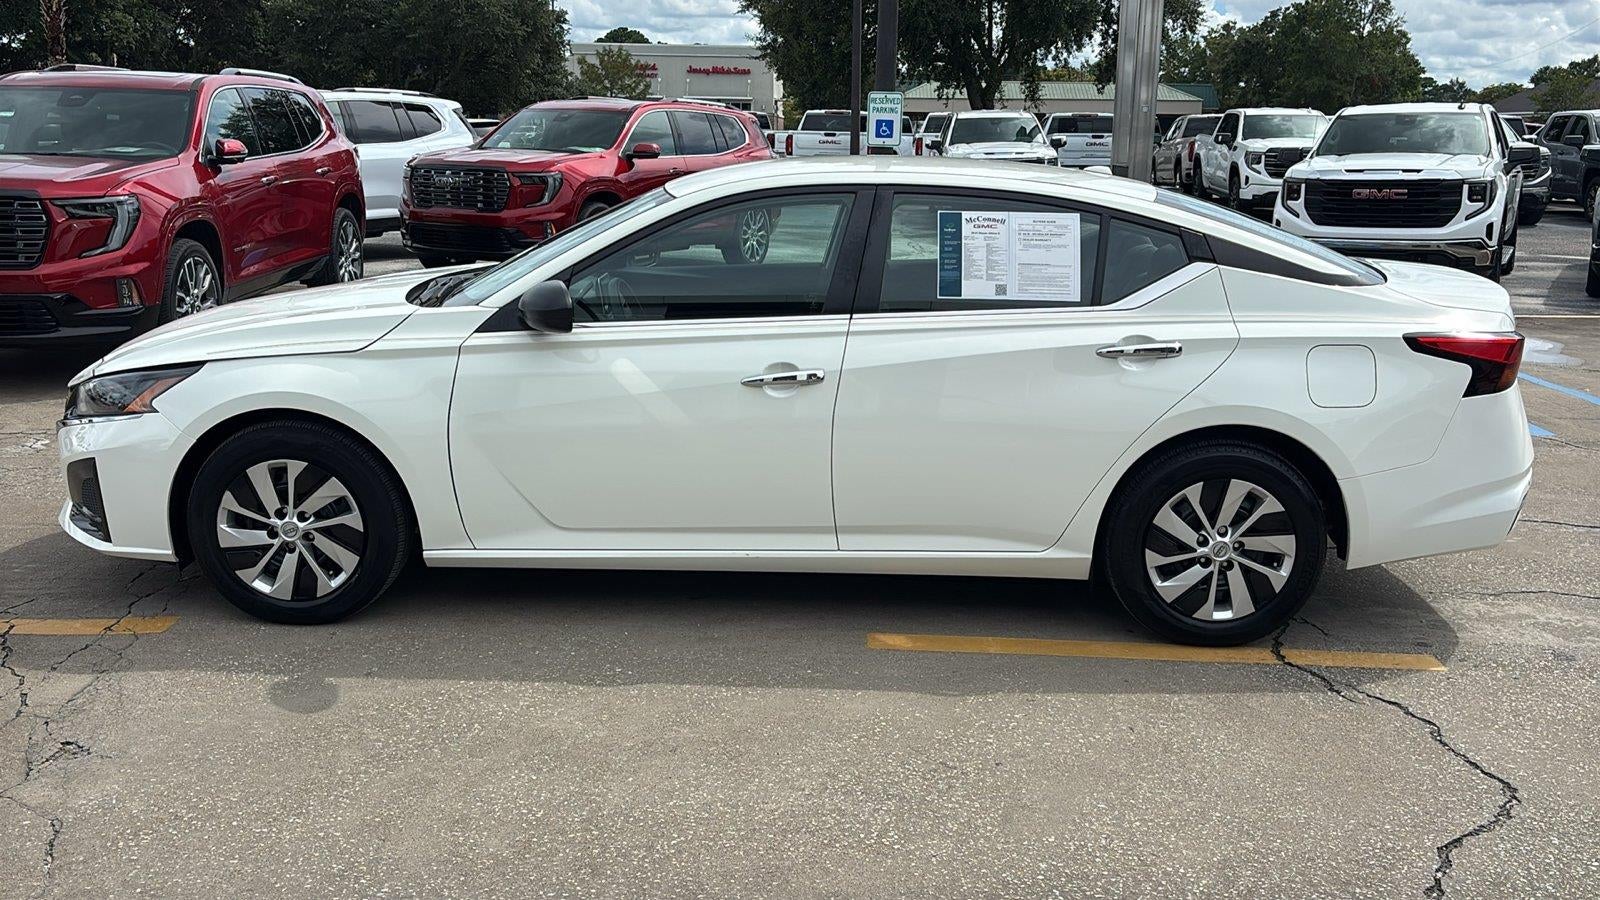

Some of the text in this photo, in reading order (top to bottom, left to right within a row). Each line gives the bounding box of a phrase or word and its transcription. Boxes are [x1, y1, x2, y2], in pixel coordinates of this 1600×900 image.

[871, 97, 900, 105] RESERVED
[872, 106, 898, 114] PARKING
[1352, 188, 1408, 199] GMC
[965, 215, 1007, 225] McConnell
